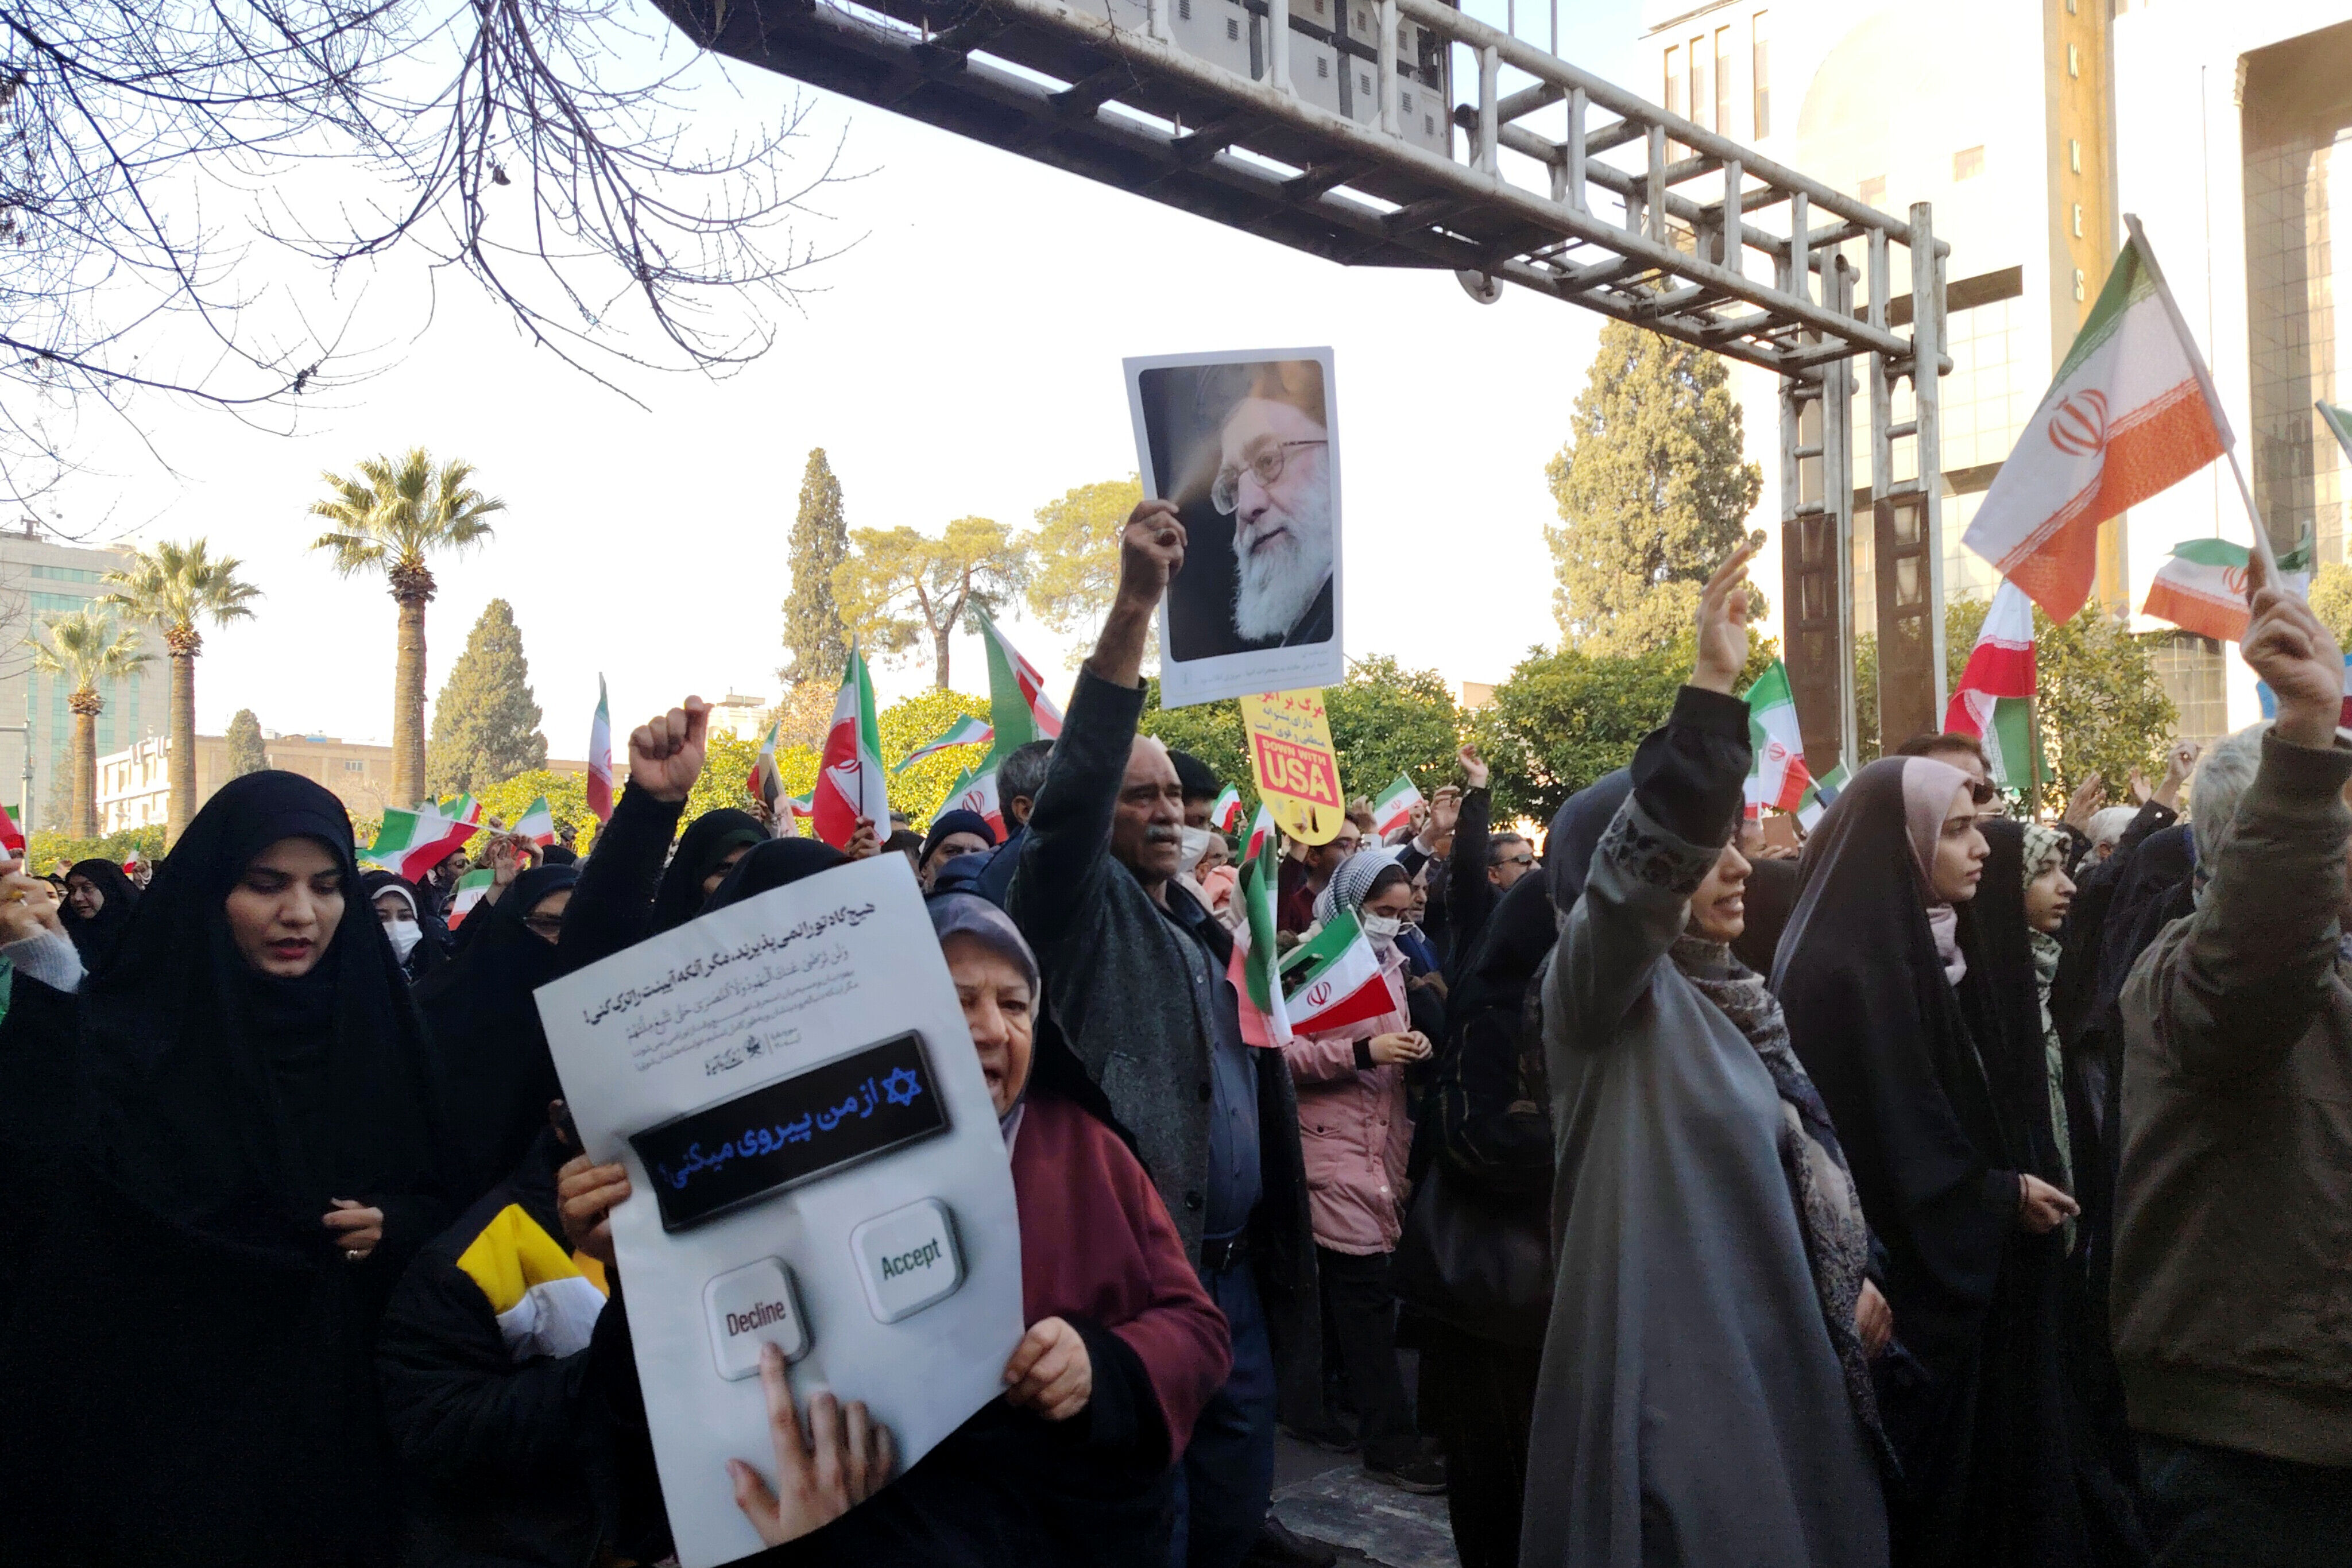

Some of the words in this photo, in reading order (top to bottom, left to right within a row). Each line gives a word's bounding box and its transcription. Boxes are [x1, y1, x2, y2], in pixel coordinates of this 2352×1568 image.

[1284, 696, 1295, 711] بر
[1262, 739, 1296, 757] DOWN
[1297, 748, 1327, 766] WITH
[1264, 750, 1333, 802] USA
[817, 1096, 858, 1132] من
[736, 1112, 813, 1157] پیروی
[881, 1237, 942, 1281] Accept
[726, 1300, 787, 1337] Decline
